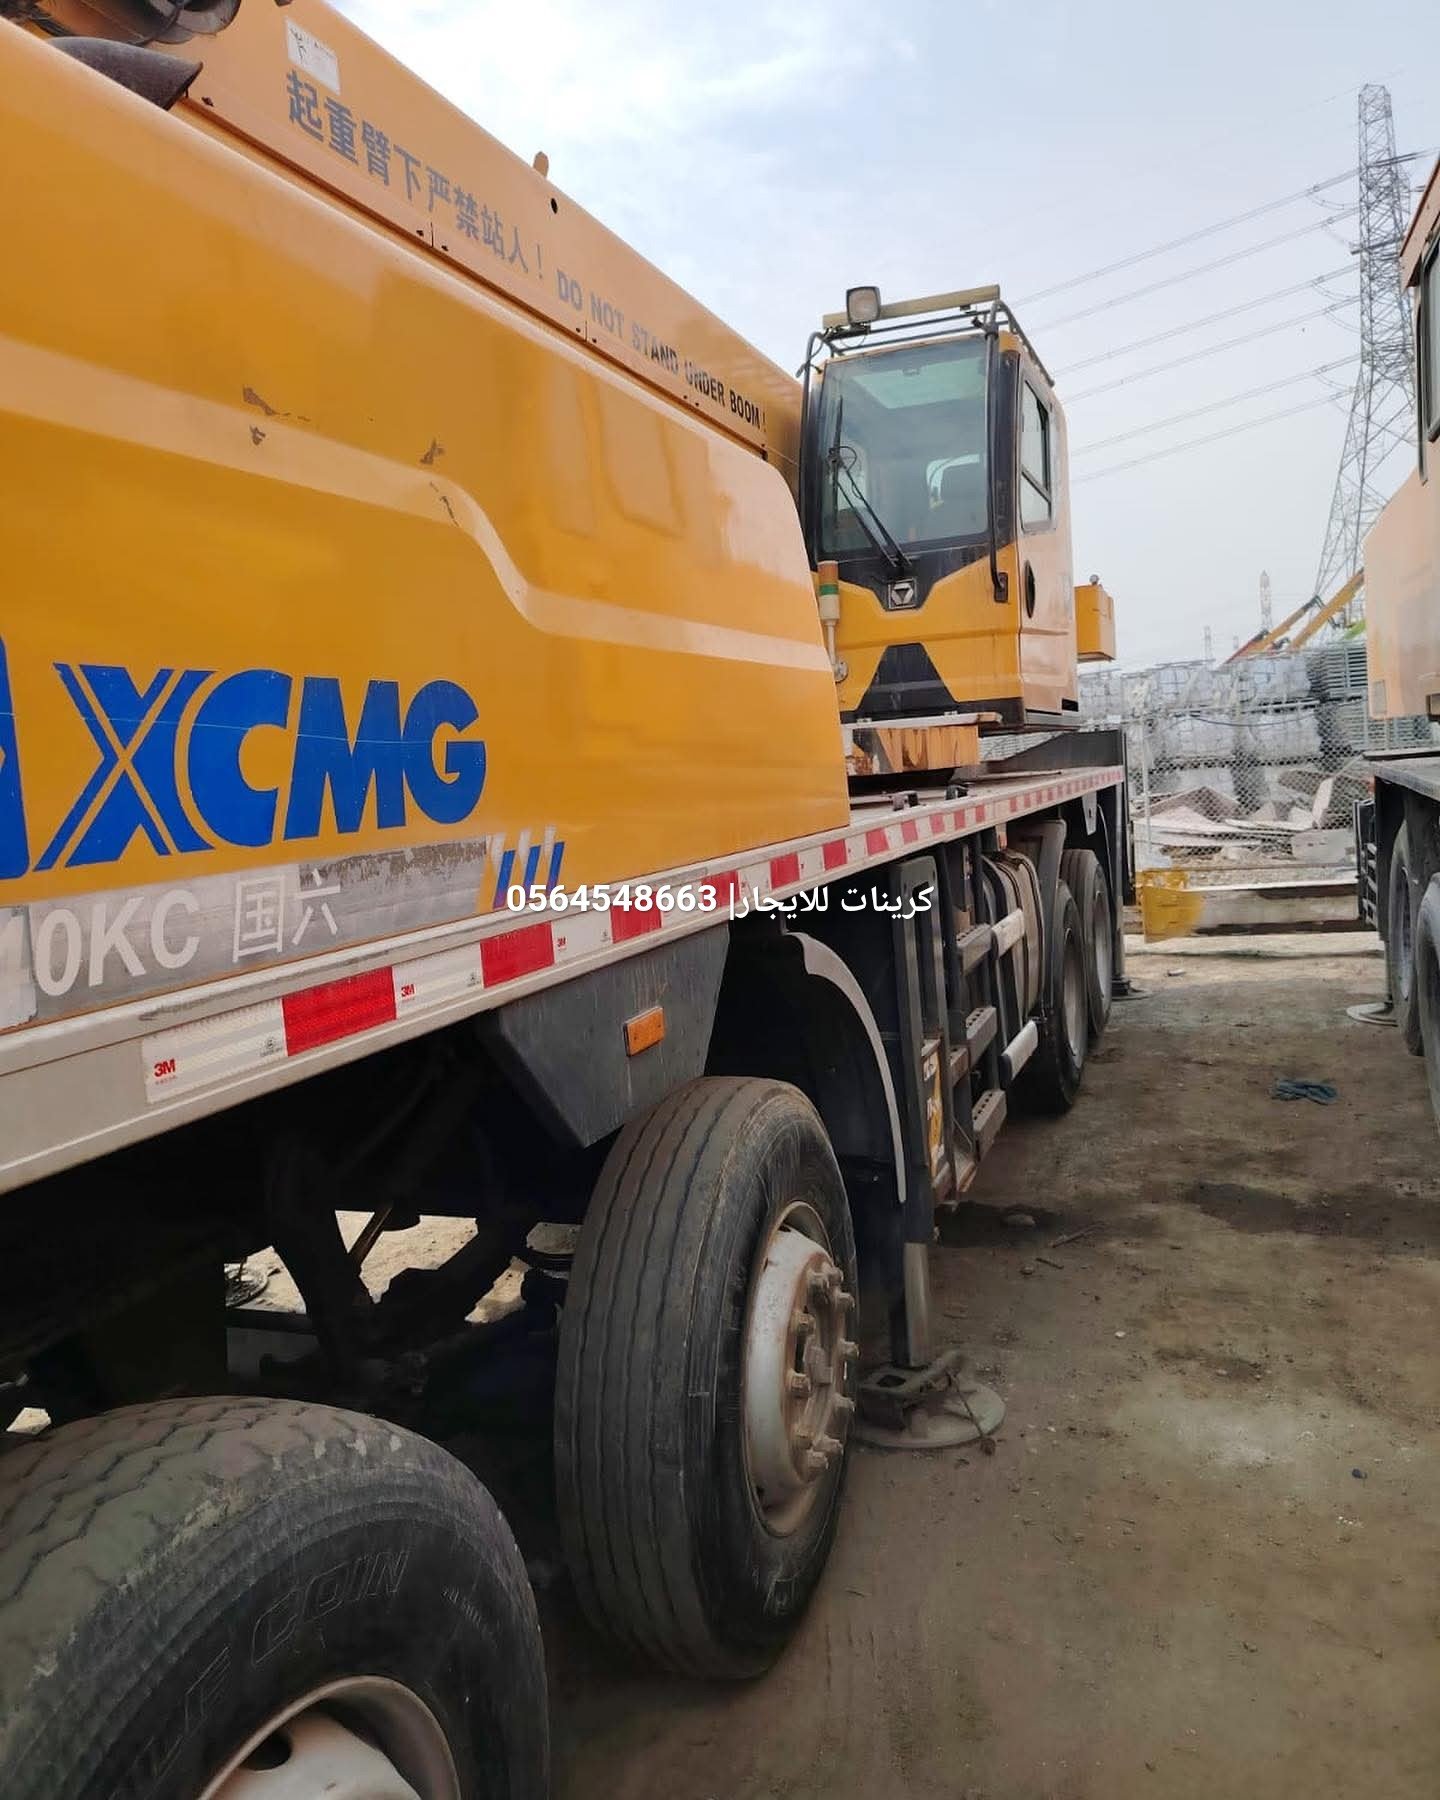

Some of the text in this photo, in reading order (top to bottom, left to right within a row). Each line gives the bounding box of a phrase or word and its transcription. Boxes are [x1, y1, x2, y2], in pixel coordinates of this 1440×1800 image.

[556, 269, 584, 312] DO
[591, 291, 625, 339] NOT
[632, 321, 679, 376] STAND
[684, 359, 726, 407] UNDER
[34, 661, 488, 873] XCMG
[401, 983, 416, 998] 3M
[154, 1058, 176, 1077] 3M
